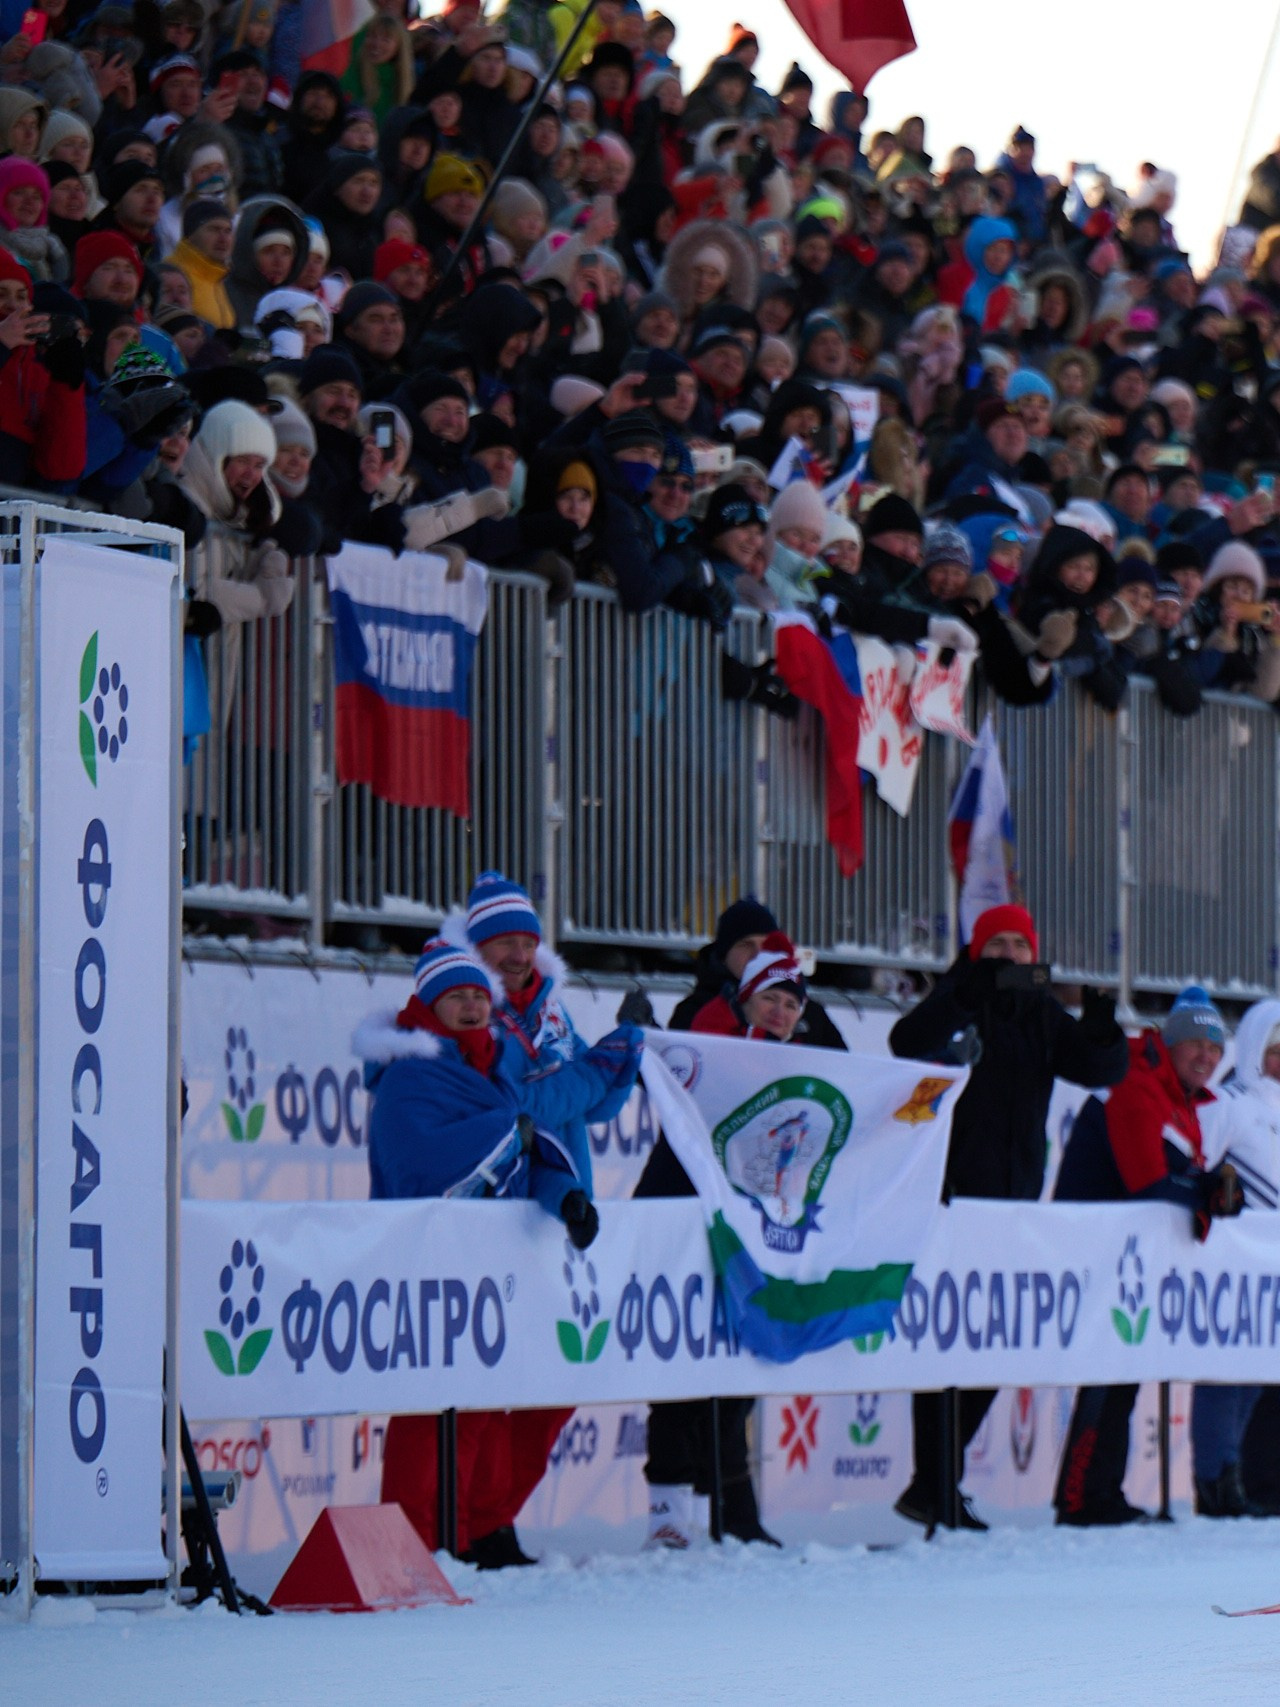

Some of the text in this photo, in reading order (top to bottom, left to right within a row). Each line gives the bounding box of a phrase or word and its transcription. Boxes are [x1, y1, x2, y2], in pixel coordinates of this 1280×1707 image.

[70, 818, 112, 1465] ФОСАГРО
[280, 1276, 507, 1375] ФОСАГРО
[899, 1270, 1081, 1352] ФОСАГРО
[191, 1438, 264, 1480] OSCO
